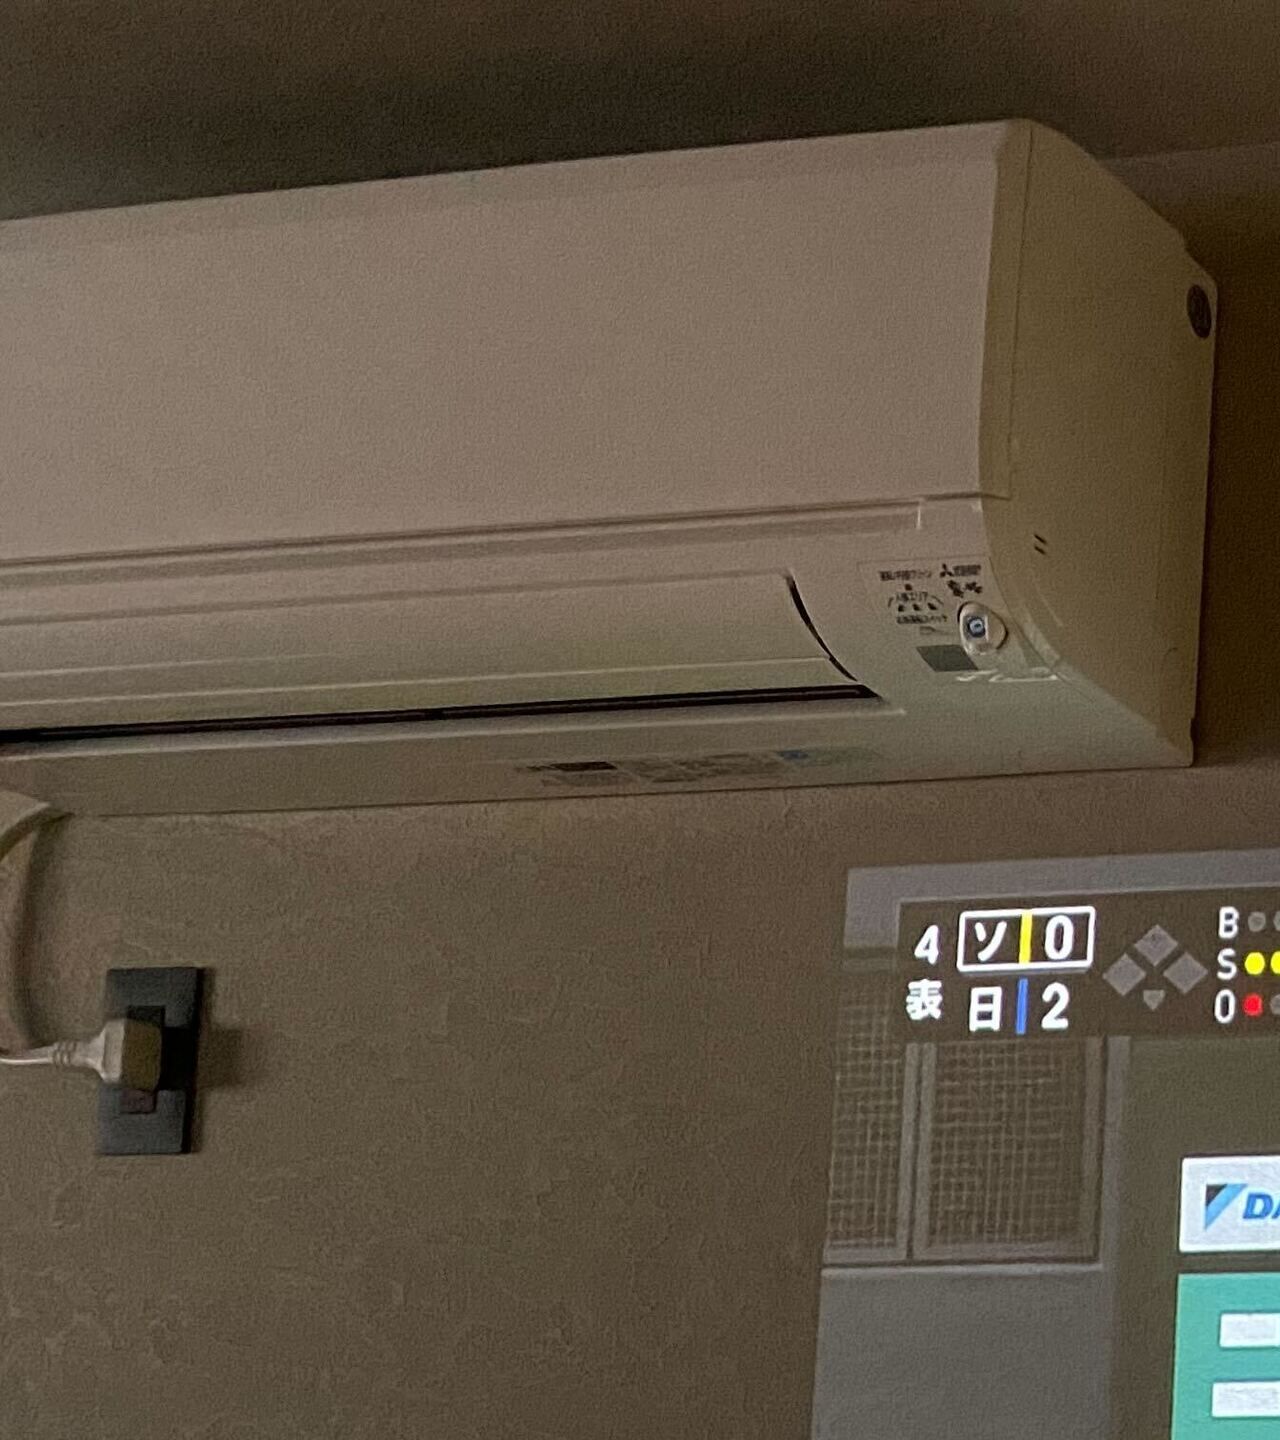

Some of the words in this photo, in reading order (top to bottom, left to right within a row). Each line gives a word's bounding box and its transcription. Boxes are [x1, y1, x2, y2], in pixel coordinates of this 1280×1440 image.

[973, 920, 1009, 963] ソ
[1045, 915, 1074, 959] 0
[1218, 906, 1239, 939] B
[913, 924, 940, 965] 4
[1217, 947, 1238, 980] S
[905, 979, 943, 1021] 表
[968, 986, 1003, 1033] 日
[1041, 982, 1070, 1030] 2
